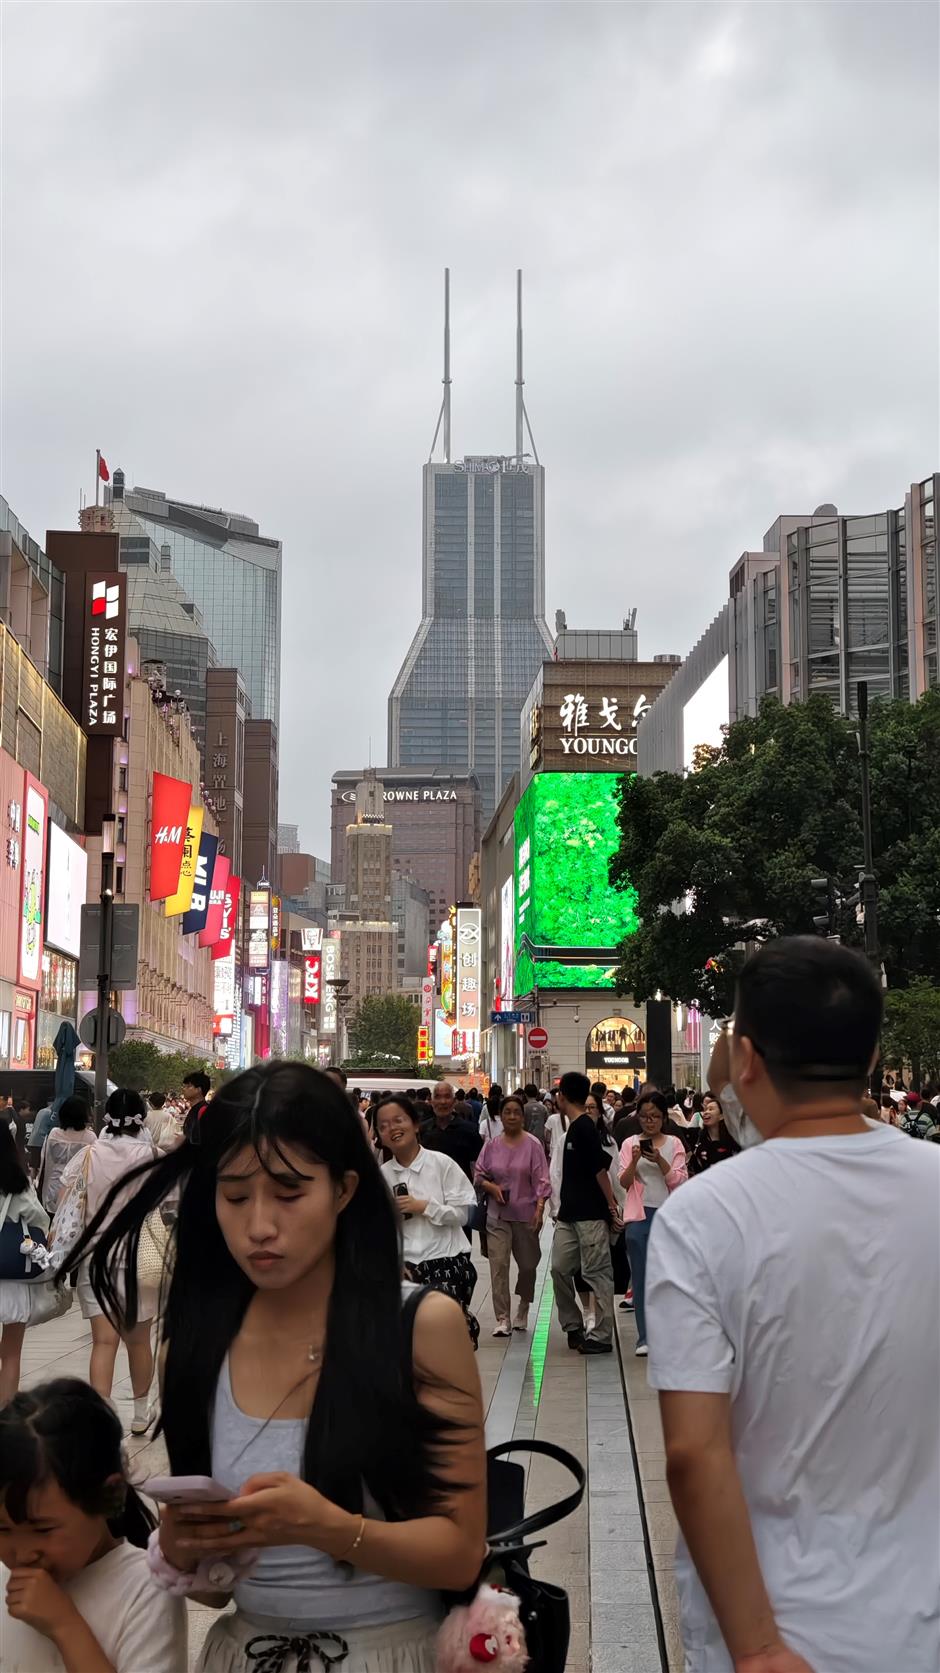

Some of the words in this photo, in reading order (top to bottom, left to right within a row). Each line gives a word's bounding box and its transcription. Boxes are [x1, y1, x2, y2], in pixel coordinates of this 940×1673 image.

[90, 627, 100, 678] HONGYI
[102, 628, 119, 725] 宏伊国际广场
[88, 684, 99, 726] PLAZA
[382, 790, 419, 801] ROWNE
[423, 790, 457, 801] PLAZA
[154, 826, 183, 845] H&M
[209, 889, 224, 900] UJI
[305, 959, 319, 999] KFC
[461, 952, 477, 1018] 创趣场
